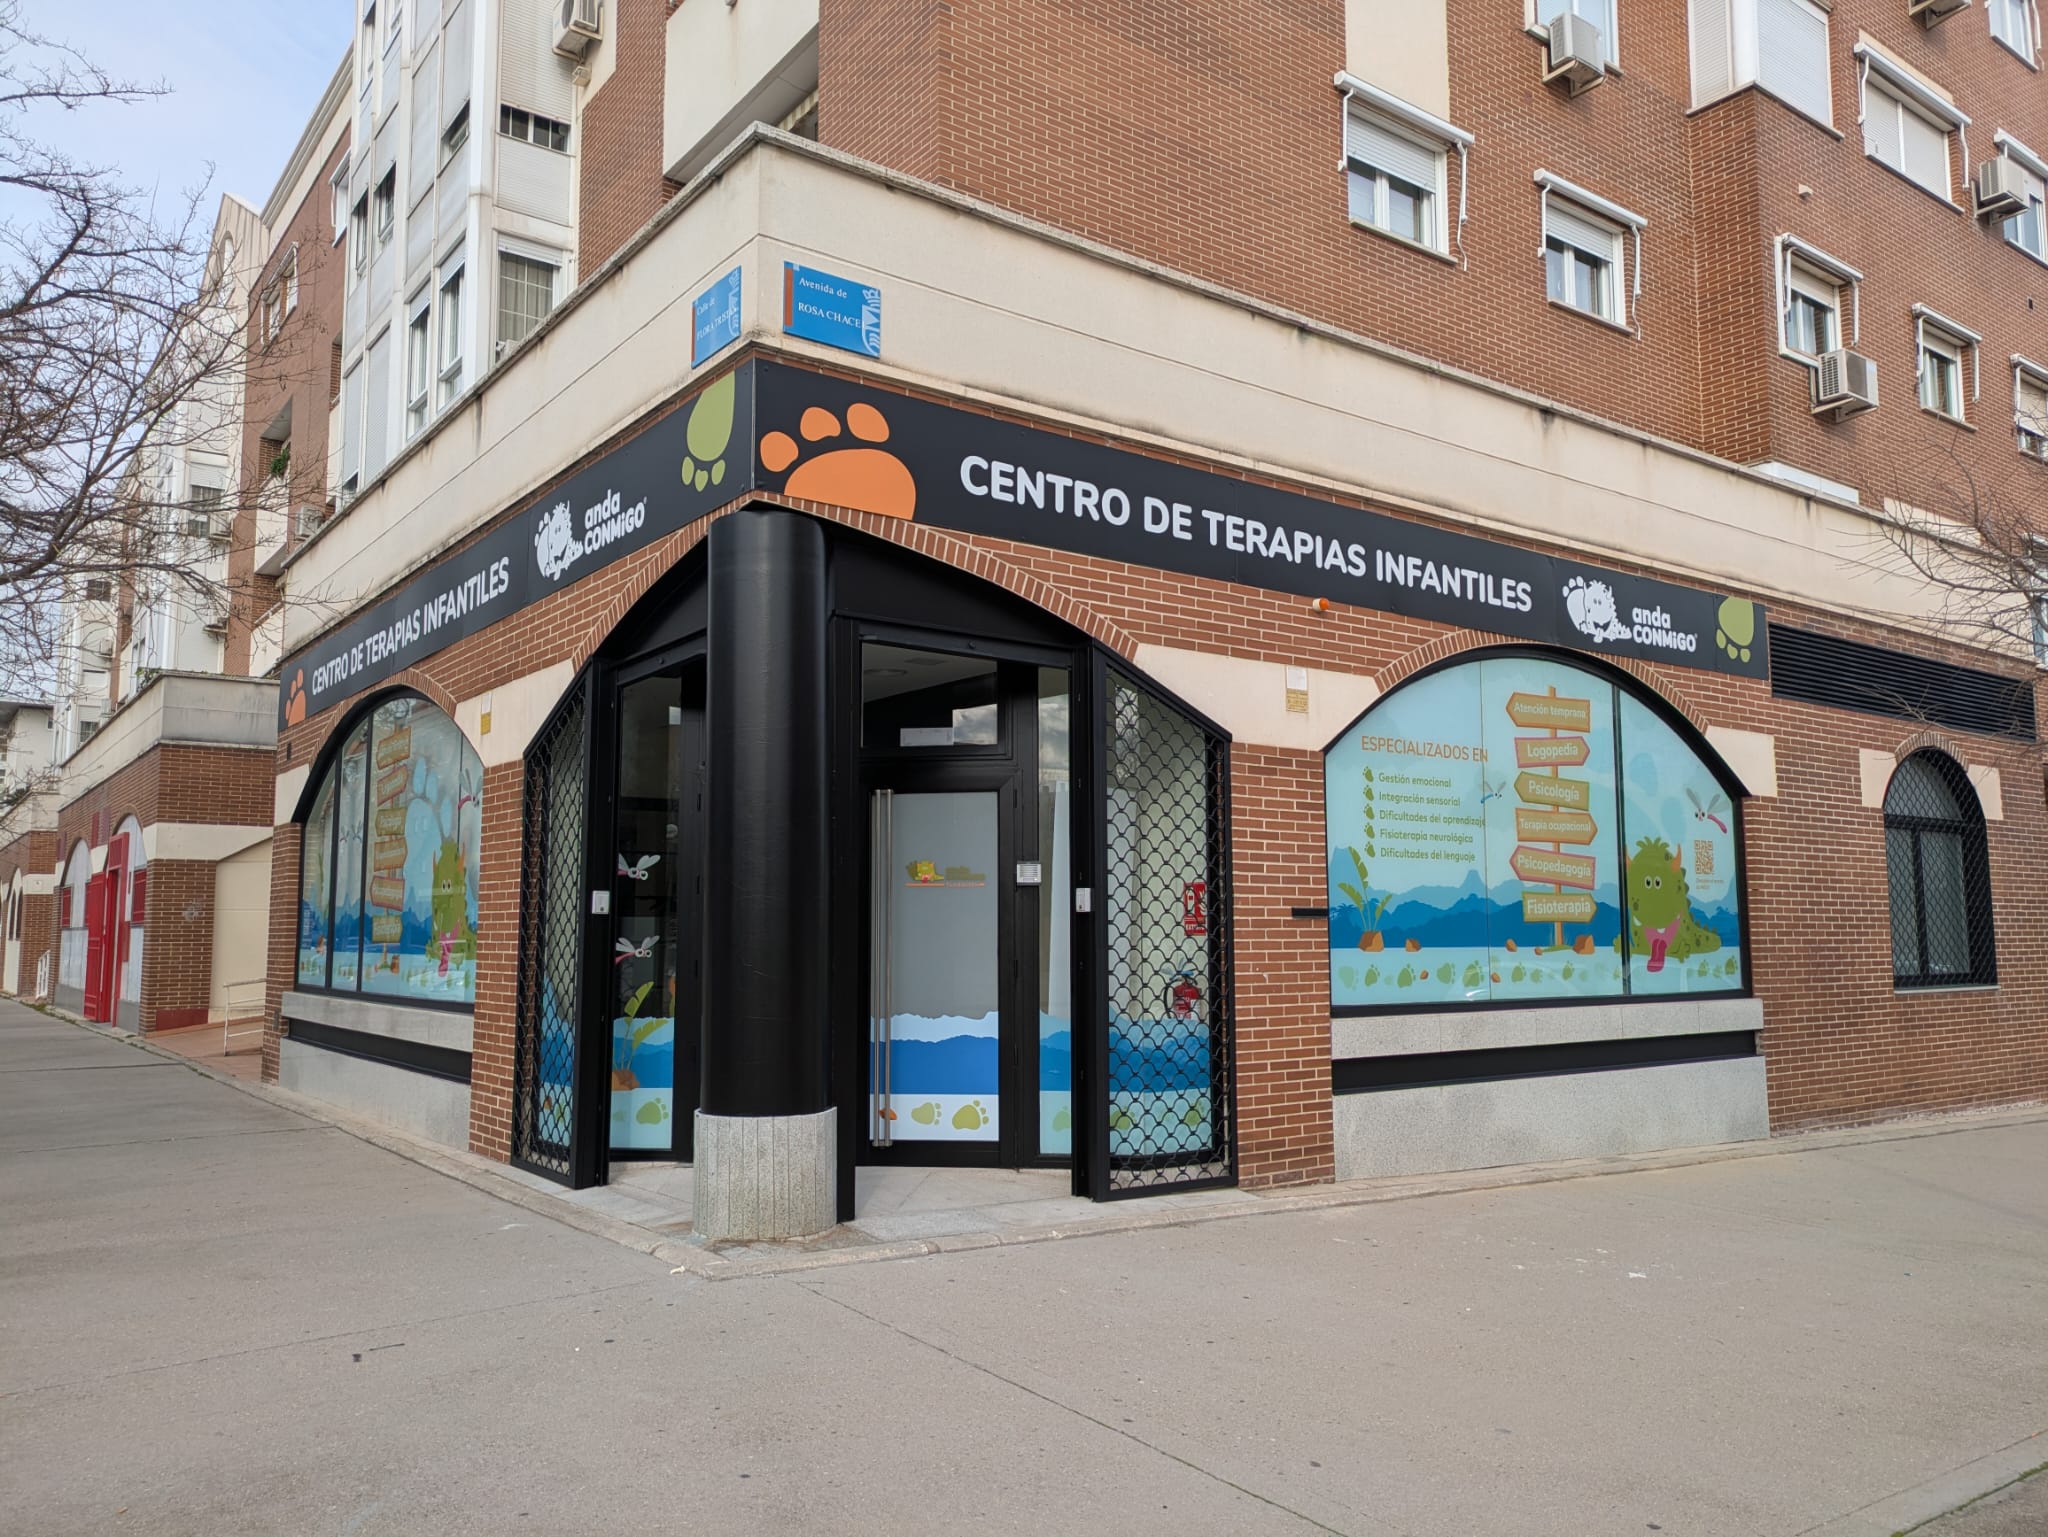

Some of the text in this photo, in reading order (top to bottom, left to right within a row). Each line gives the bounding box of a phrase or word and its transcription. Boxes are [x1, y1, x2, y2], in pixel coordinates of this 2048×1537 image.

[799, 277, 848, 299] Avenida de
[798, 301, 825, 318] ROSA
[584, 488, 621, 530] anda
[960, 455, 1533, 612] CENTRO DE TERAPIAS INFANTILES
[1632, 605, 1671, 629] anda
[312, 556, 510, 697] CENTRO DE TERAPIAS INFANTILES
[1513, 702, 1586, 720] Atención temprana
[1361, 735, 1488, 762] ESPECIALIZADOS EN
[1527, 742, 1579, 760] Logopedia
[1378, 772, 1452, 788] Gestión emocional
[1379, 792, 1461, 806] Integración sensorial
[1528, 780, 1580, 802] Psicología
[1379, 810, 1428, 823] Dificultades
[1429, 813, 1441, 824] del
[1520, 819, 1591, 833] Terapia ocupacional
[1380, 828, 1474, 846] Fisioterapia neurológica
[1380, 847, 1476, 864] Dificultades del lenguaje
[1518, 855, 1592, 878] Psicopedagogía
[1527, 897, 1592, 916] Fisioterapia
